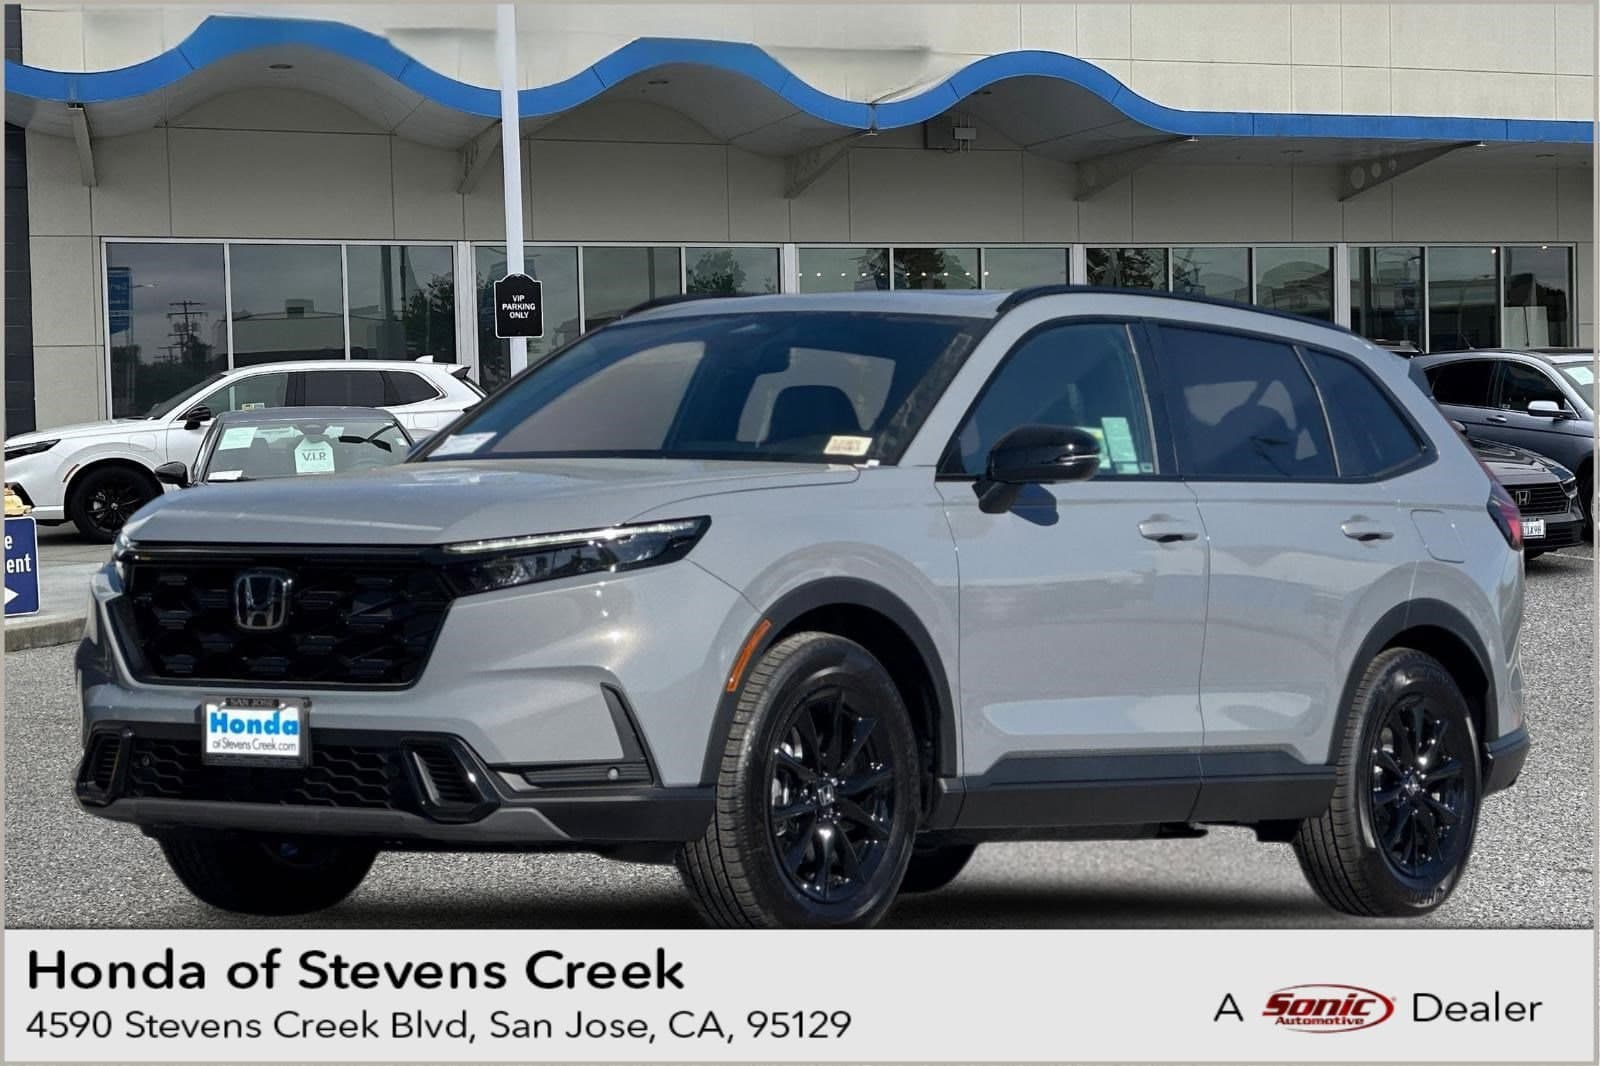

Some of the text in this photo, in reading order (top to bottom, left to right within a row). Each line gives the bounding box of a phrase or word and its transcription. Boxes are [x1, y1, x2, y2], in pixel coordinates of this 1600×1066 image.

[512, 294, 525, 302] VIP
[509, 311, 529, 319] ONLY
[210, 710, 299, 735] Honda
